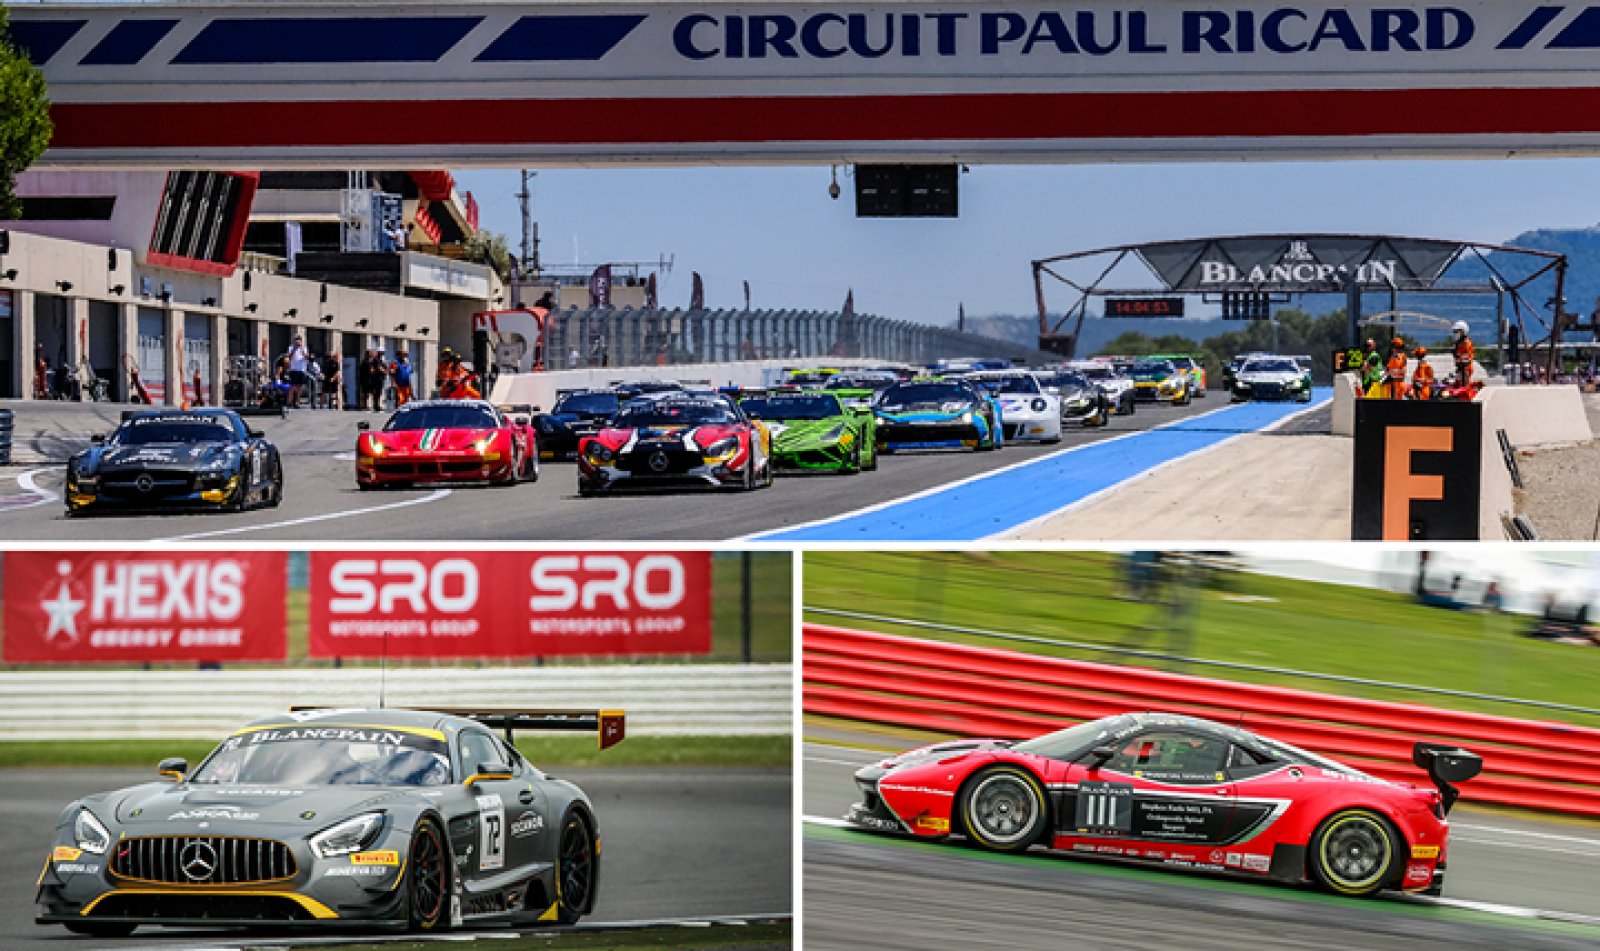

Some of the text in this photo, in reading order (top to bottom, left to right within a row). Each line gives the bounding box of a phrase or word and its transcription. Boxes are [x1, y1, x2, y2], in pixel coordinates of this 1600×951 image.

[672, 7, 1474, 60] CIRCUIT PAUL RICARD
[1335, 352, 1345, 369] F
[1381, 426, 1454, 541] F
[91, 561, 244, 622] HEXIS
[329, 559, 479, 613] SRO
[529, 555, 685, 610] SRO
[90, 629, 243, 647] ENERGY DRINK
[329, 619, 479, 637] MOTORSPORTS GROUP
[529, 616, 685, 635] MOTORSPORTS GROUP
[250, 728, 406, 746] BLANCPAIN
[1086, 794, 1117, 826] 111
[485, 814, 500, 856] 72
